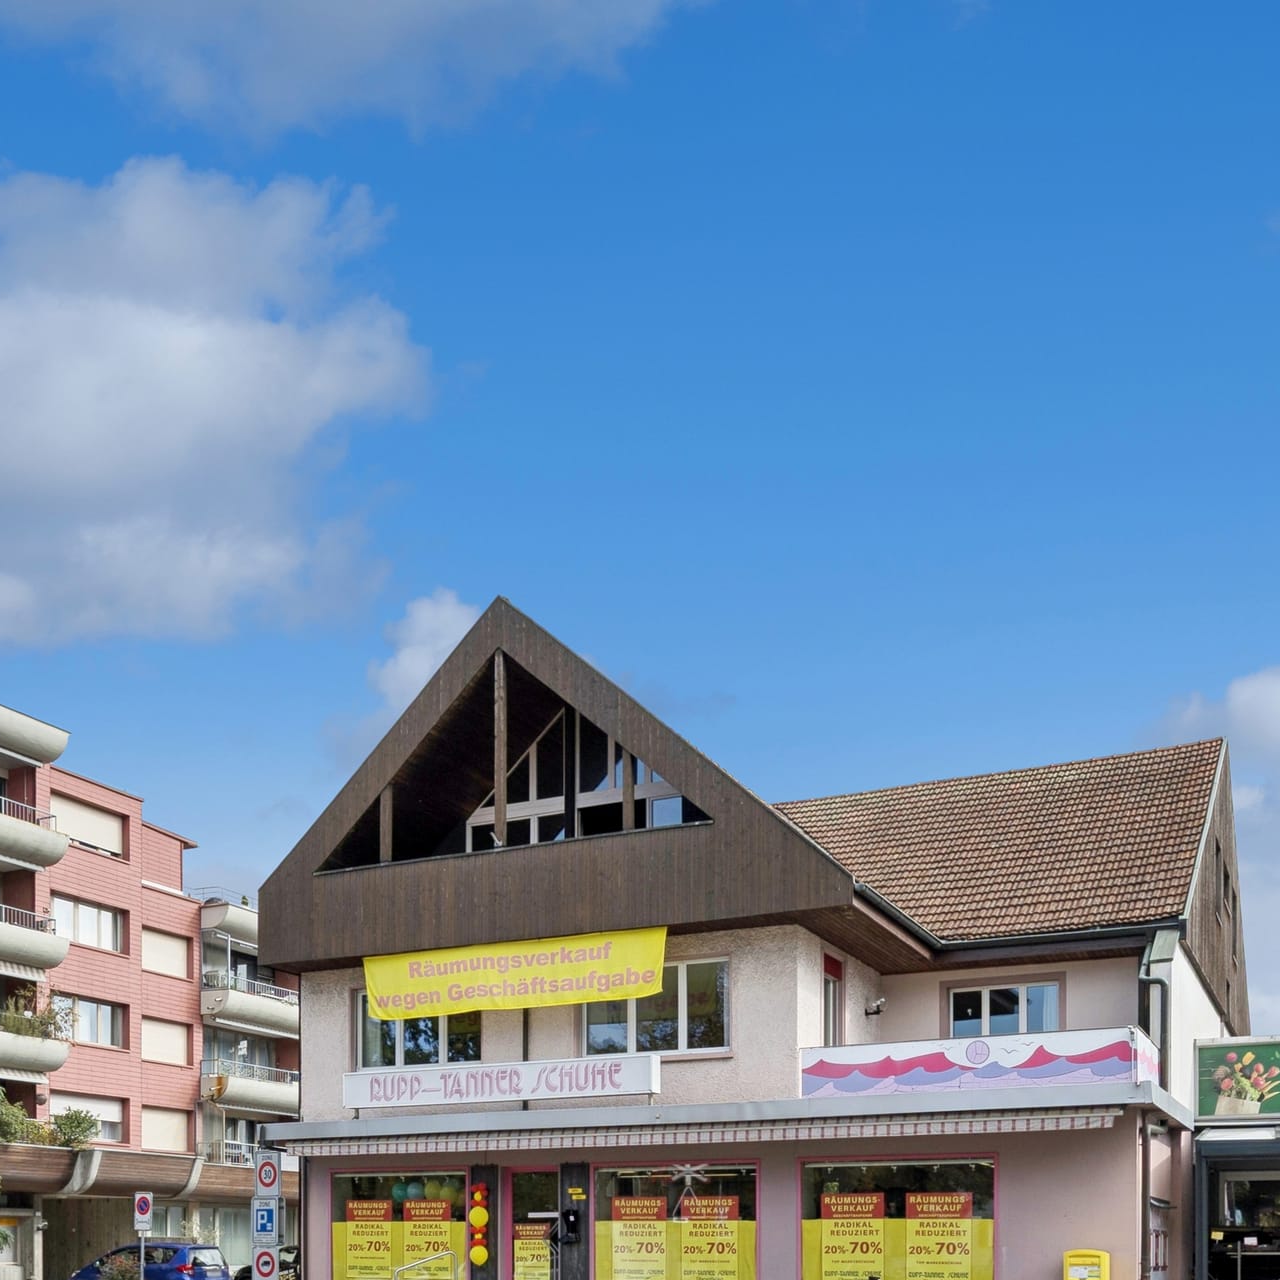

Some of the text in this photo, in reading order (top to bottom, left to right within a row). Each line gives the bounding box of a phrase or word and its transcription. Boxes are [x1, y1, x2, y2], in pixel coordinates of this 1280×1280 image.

[408, 941, 613, 980] Räumungsverkauf
[376, 967, 656, 1010] wegen Geschäftsaufgabe
[530, 1061, 624, 1094] SCHUHE
[263, 1168, 272, 1180] 30
[614, 1198, 665, 1207] RÄUMUNGS-
[683, 1198, 737, 1207] RÄUMUNGS-
[824, 1196, 881, 1204] RÄUMUNGS-
[909, 1195, 969, 1204] RÄUMUNGS-
[410, 1208, 444, 1216] VERKAUF
[620, 1207, 659, 1215] VERKAUF
[689, 1206, 730, 1215] VERKAUF
[830, 1204, 876, 1212] VERKAUF
[916, 1204, 963, 1212] VERKAUF
[830, 1229, 880, 1237] REDUZIERT
